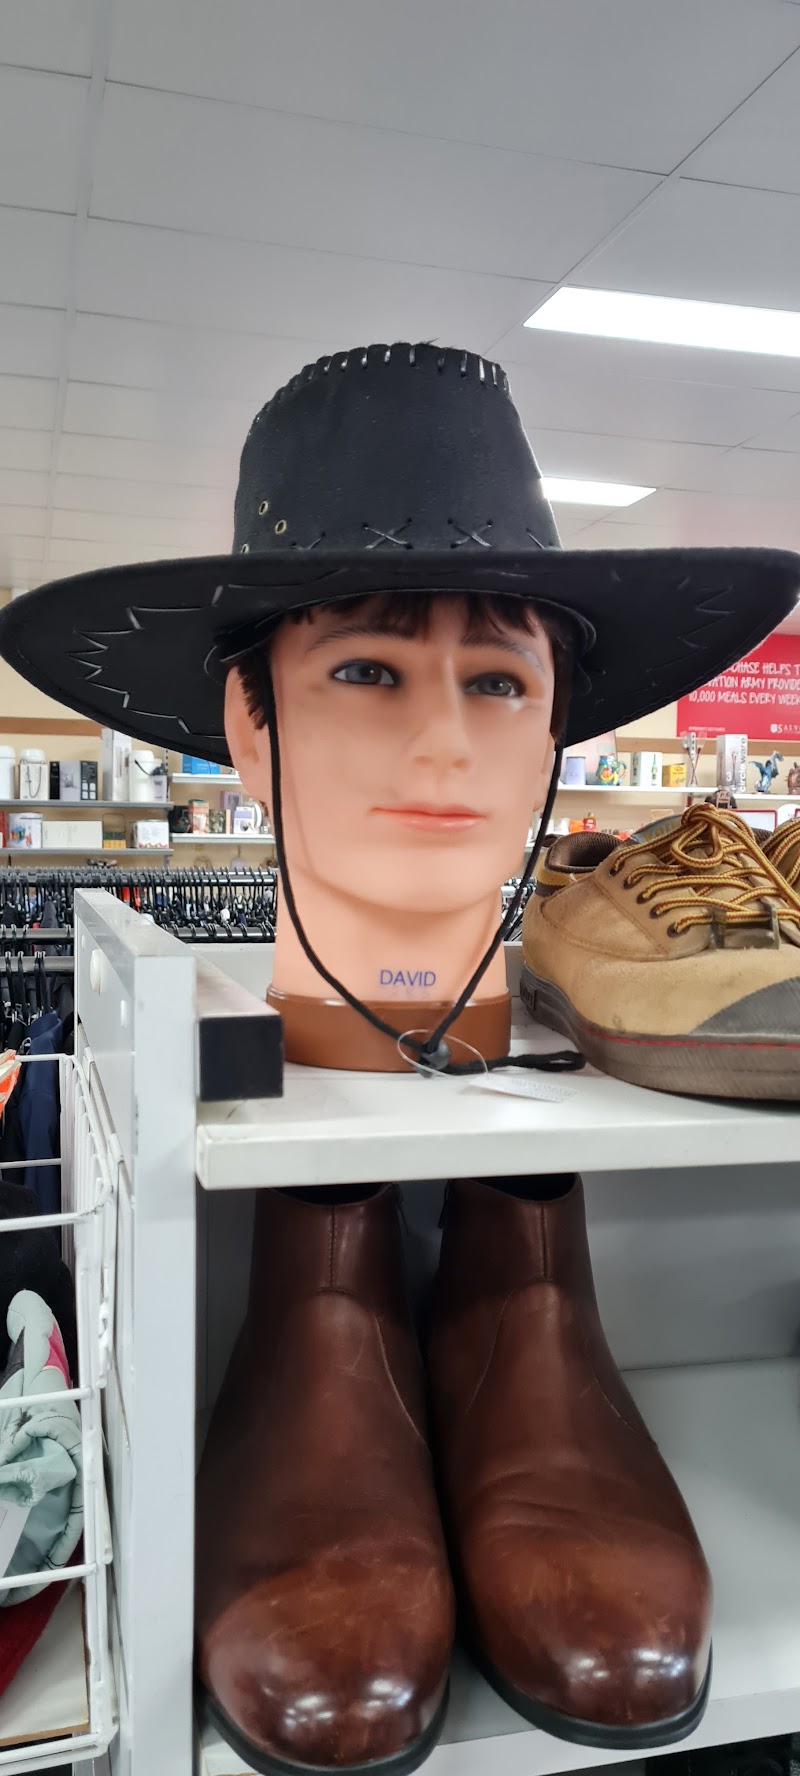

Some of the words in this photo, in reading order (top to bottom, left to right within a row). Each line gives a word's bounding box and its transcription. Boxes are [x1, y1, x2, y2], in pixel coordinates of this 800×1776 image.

[730, 661, 760, 674] CHASE
[762, 662, 791, 675] HELPS
[741, 677, 765, 689] ARMY
[689, 690, 715, 702] 10,000
[718, 691, 747, 704] MEALS
[749, 692, 776, 704] EVERY
[380, 969, 436, 986] DAVID
